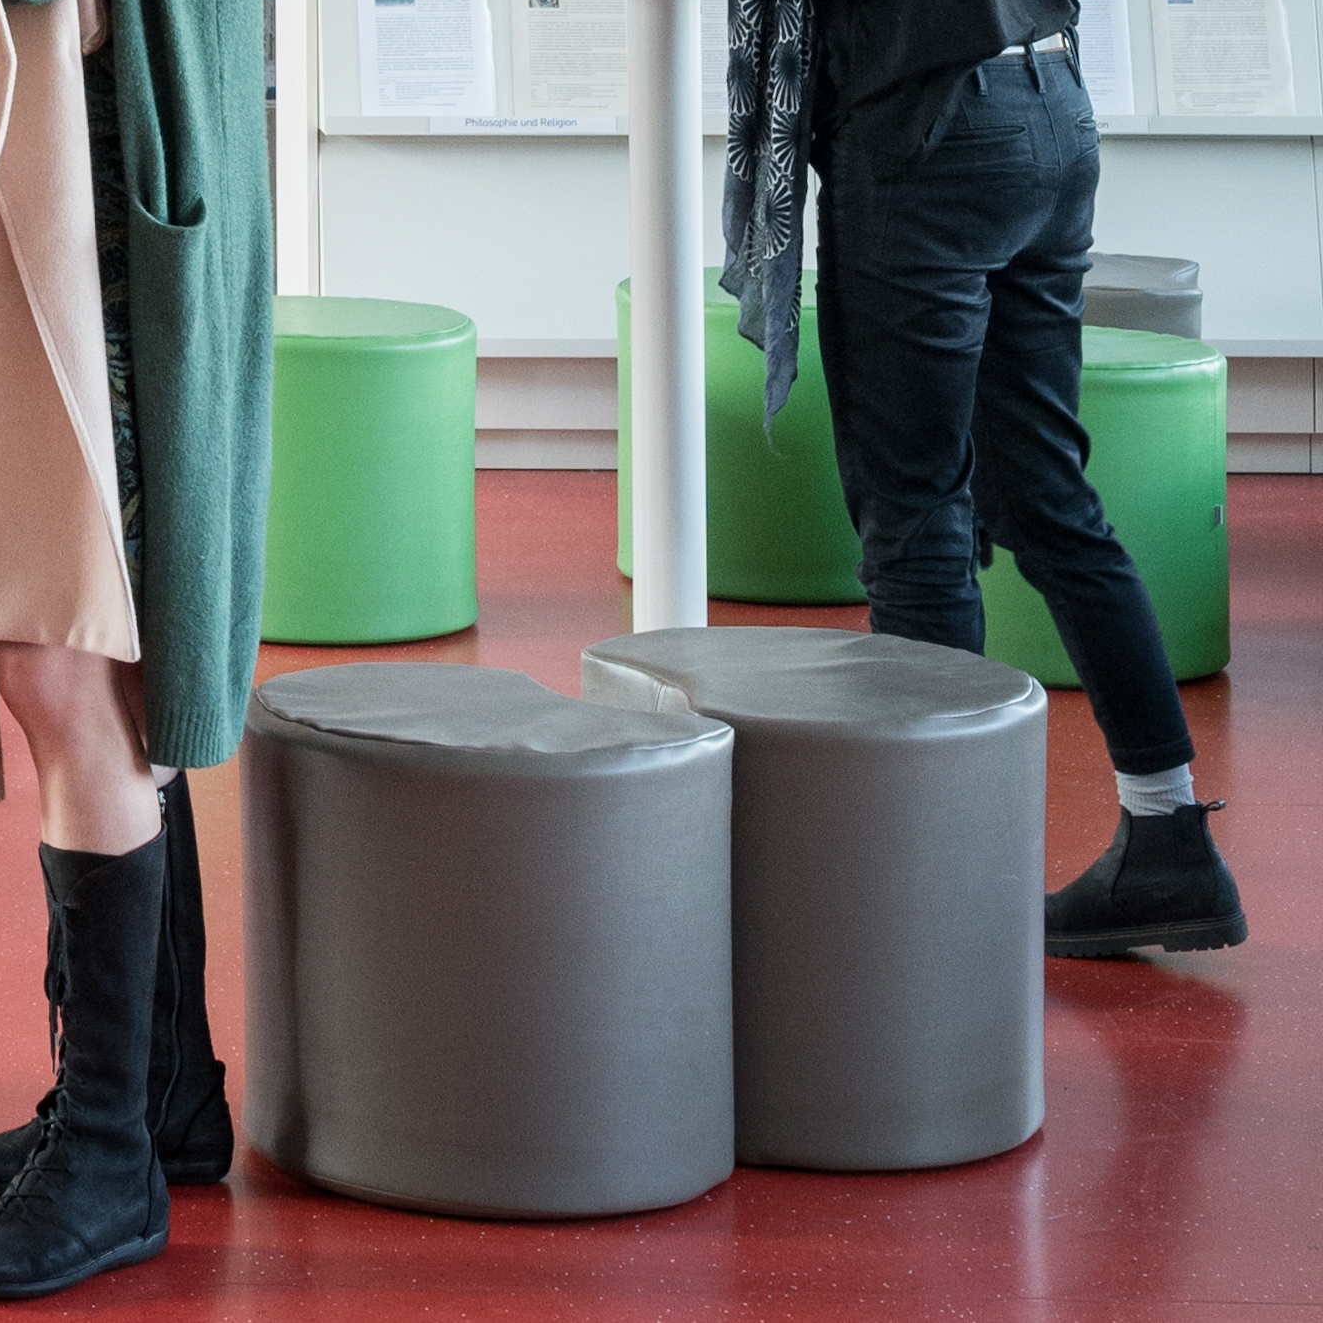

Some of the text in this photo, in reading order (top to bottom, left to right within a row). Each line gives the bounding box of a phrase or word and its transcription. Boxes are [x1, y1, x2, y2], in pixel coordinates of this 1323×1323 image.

[464, 117, 577, 129] Philosophie und Religion
